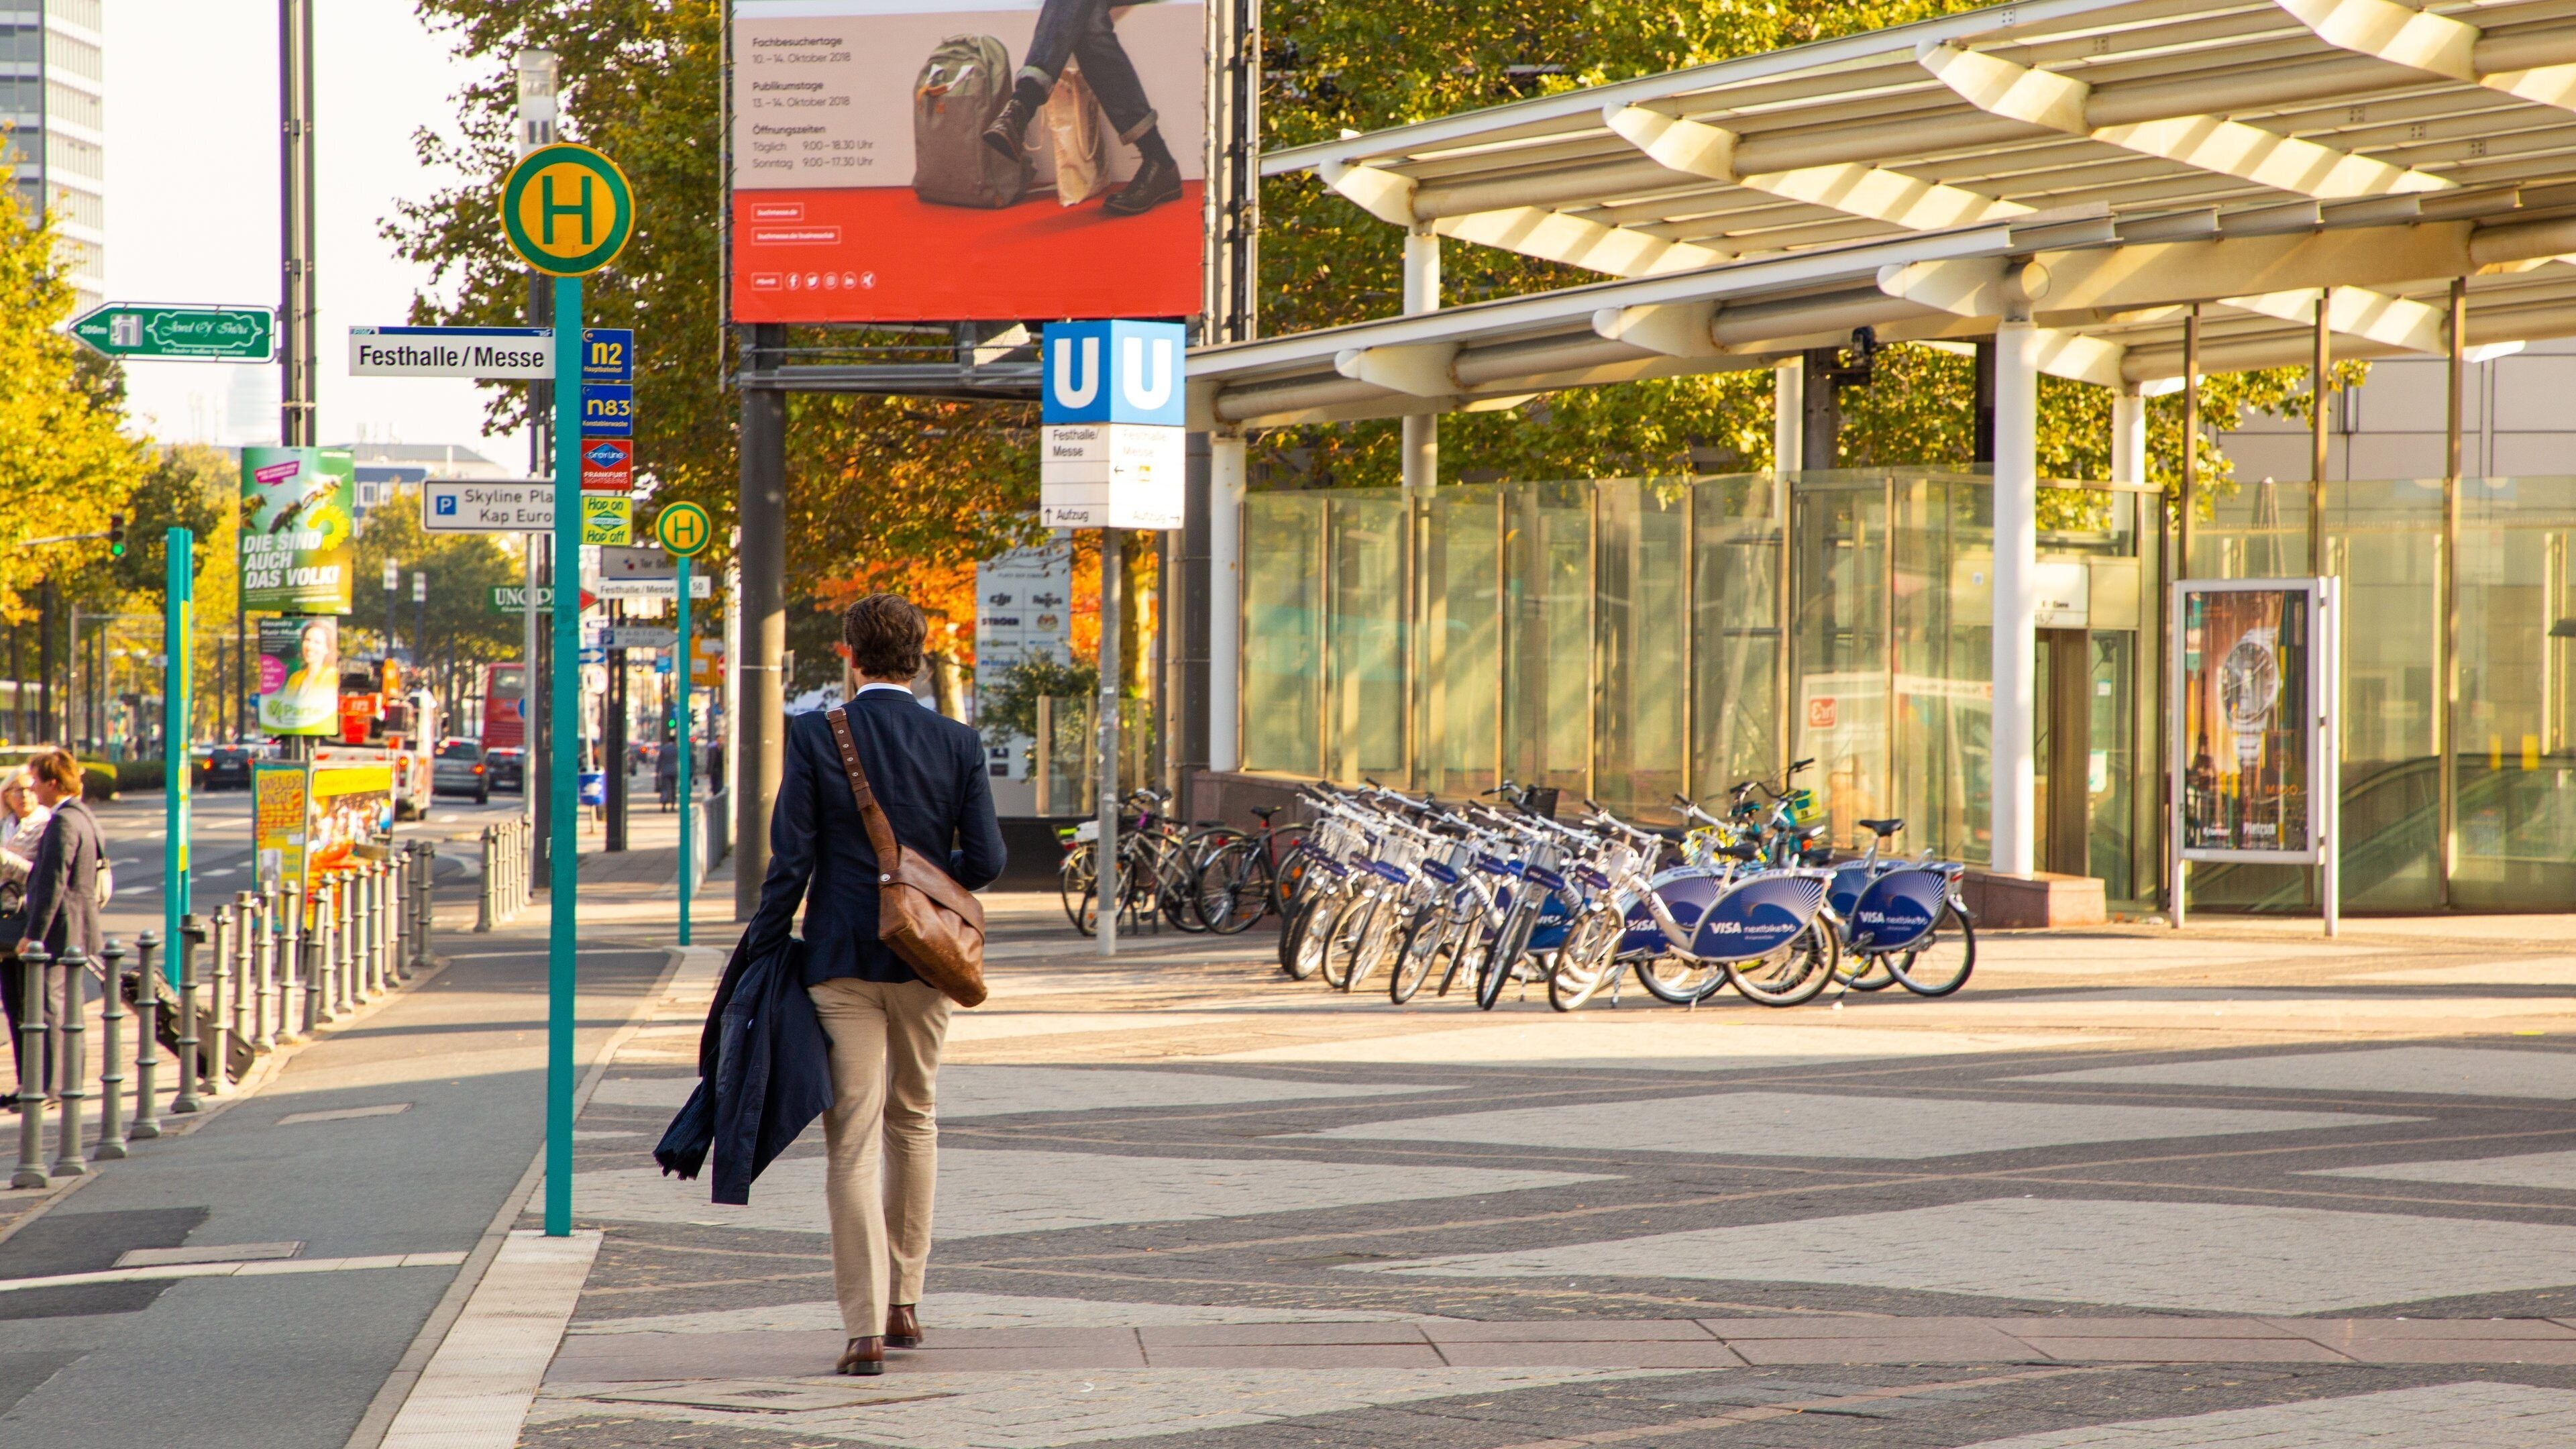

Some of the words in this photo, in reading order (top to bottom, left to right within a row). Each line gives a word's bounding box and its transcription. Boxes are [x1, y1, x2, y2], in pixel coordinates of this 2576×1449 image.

[752, 37, 843, 47] Fachbesuchertage
[787, 52, 827, 63] Oktober
[829, 52, 851, 62] 2018
[752, 81, 824, 92] Publikumstage
[786, 97, 826, 107] Oktober
[828, 96, 851, 107] 2018
[752, 123, 826, 137] Öffnungszeiten
[857, 139, 874, 150] Uhr
[752, 158, 794, 170] Sonntag
[857, 156, 874, 167] Uhr
[542, 176, 592, 244] H
[360, 345, 458, 366] Festhalle
[474, 346, 545, 368] Messe
[592, 342, 623, 365] n2
[1054, 337, 1099, 409] U
[1123, 337, 1173, 410] U
[587, 398, 631, 417] n83
[1053, 445, 1084, 457] Messe
[464, 489, 522, 504] Skyline
[529, 490, 553, 502] Pla
[588, 498, 608, 510] Hop
[611, 501, 624, 511] on
[480, 509, 510, 524] Kap
[517, 508, 553, 523] Euro
[1057, 508, 1089, 523] Aufzug
[674, 516, 694, 542] H
[244, 534, 274, 553] DIE
[277, 531, 323, 550] SIND
[586, 530, 607, 542] Hop
[610, 530, 625, 543] off
[244, 551, 294, 571] AUCH
[245, 569, 282, 590] DAS
[286, 565, 341, 586] VOLK!
[600, 585, 638, 594] Festhalle
[646, 585, 675, 593] Messe
[1858, 911, 1885, 924] VISA
[1709, 922, 1742, 934] VISA
